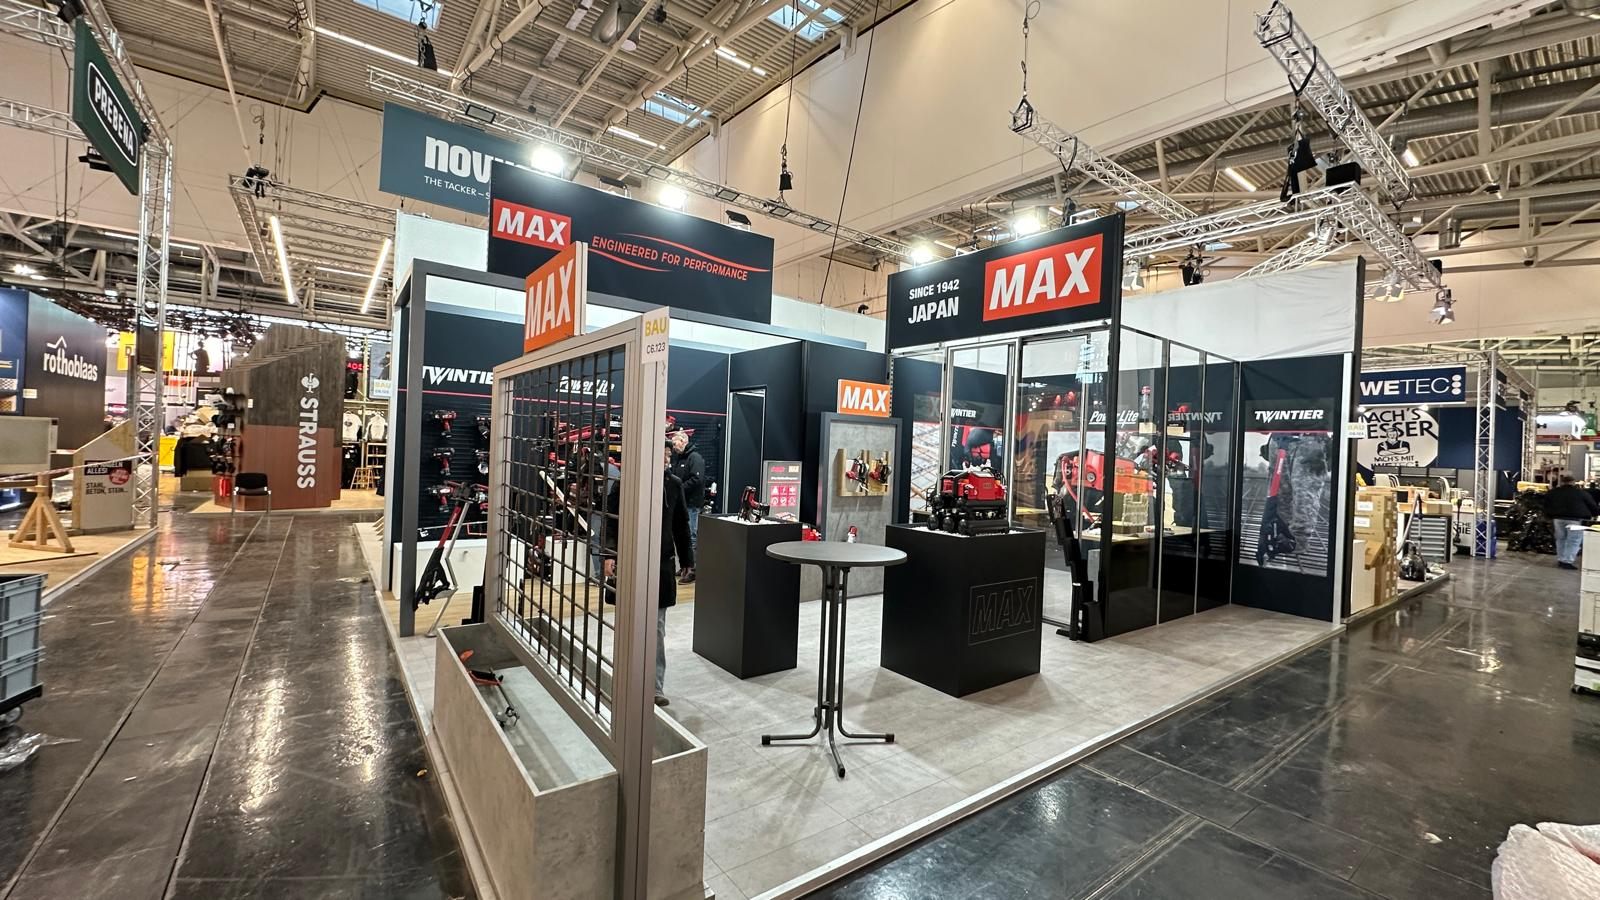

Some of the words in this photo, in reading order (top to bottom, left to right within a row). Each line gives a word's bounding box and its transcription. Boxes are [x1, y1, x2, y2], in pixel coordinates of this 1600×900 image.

[94, 76, 134, 156] PREBENA
[424, 136, 515, 184] nov
[424, 175, 442, 187] THE
[444, 180, 477, 196] TACKER
[497, 207, 568, 246] MAX
[592, 235, 658, 261] ENGINEERED
[661, 252, 681, 266] FOR
[683, 258, 748, 281] PERFORMANCE
[909, 284, 935, 300] SINCE
[937, 279, 960, 294] 1942
[988, 247, 1096, 310] MAX
[525, 258, 575, 340] MAX
[908, 296, 960, 324] JAPAN
[645, 317, 667, 336] BAU
[43, 348, 98, 381] rothoblaas
[422, 365, 493, 386] TWINTIE
[842, 385, 889, 412] MAX
[1360, 377, 1450, 396] WETEC
[1254, 410, 1324, 424] TWINTIER
[1367, 420, 1438, 440] ESSER
[296, 397, 319, 489] STRAUSS
[972, 585, 1033, 635] MAX
